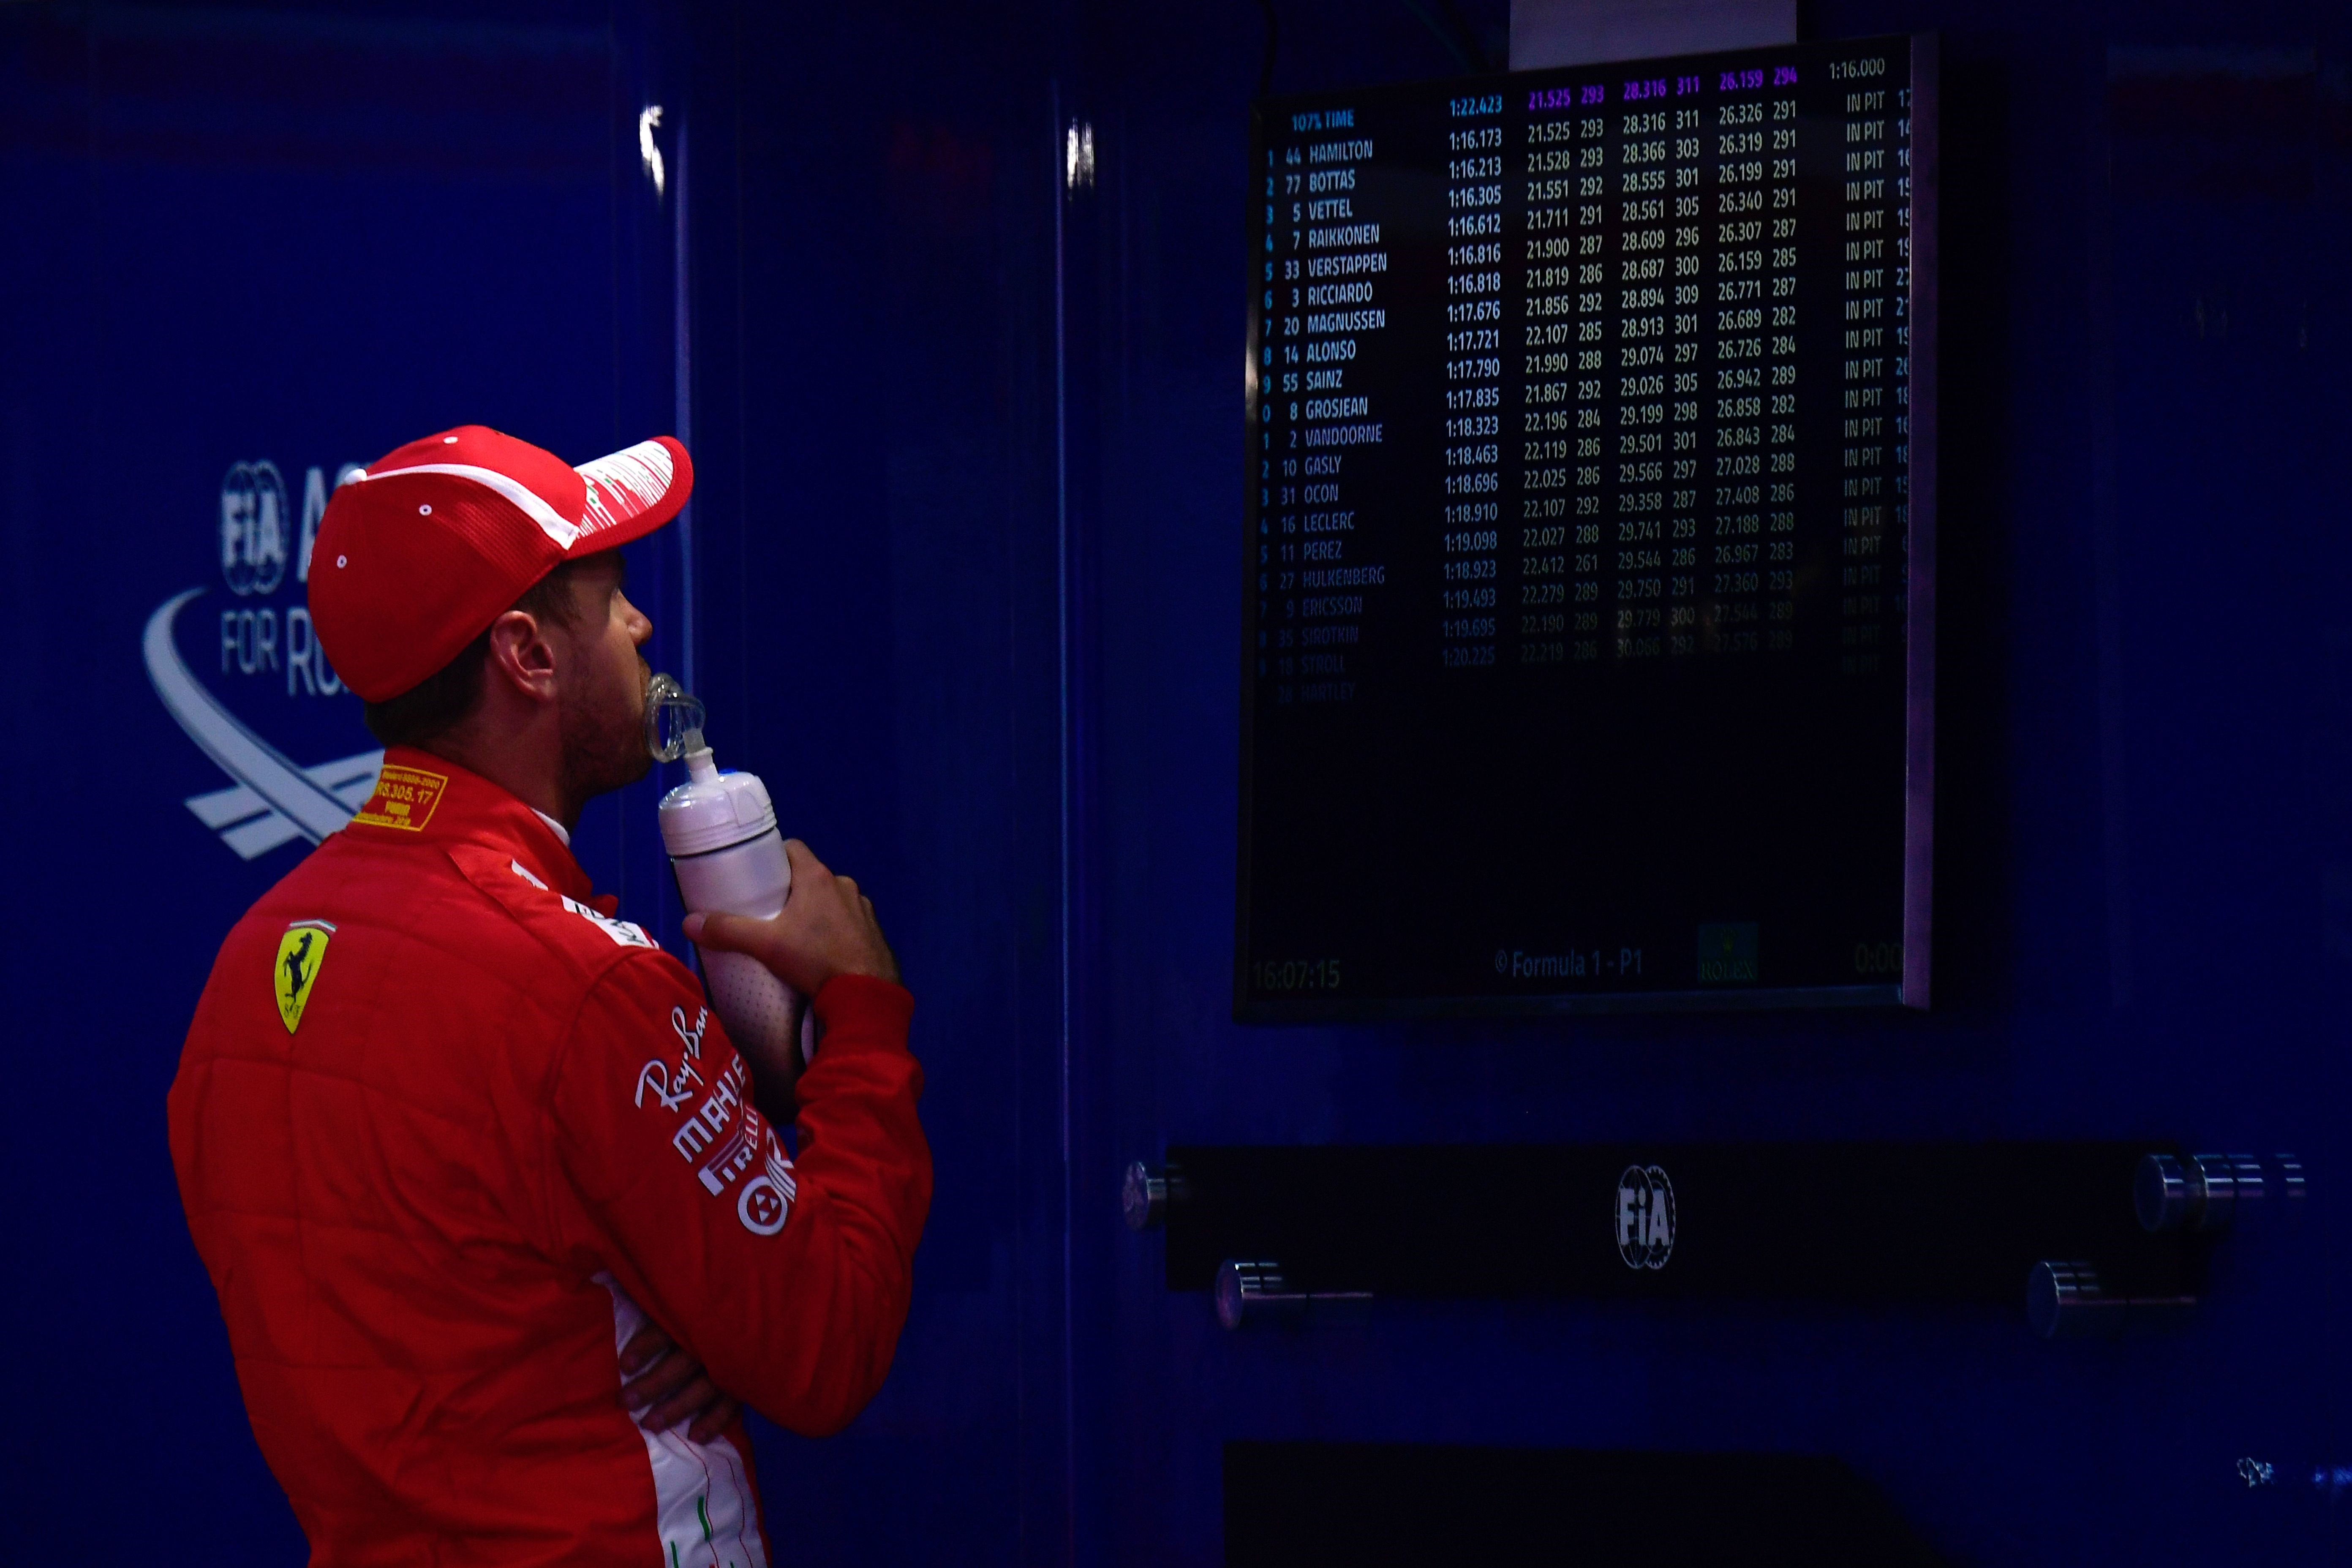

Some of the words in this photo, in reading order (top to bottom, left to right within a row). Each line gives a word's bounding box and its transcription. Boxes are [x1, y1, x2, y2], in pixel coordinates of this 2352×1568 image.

[1325, 109, 1354, 128] TIME
[1450, 95, 1502, 116] 1:22.423
[1529, 88, 1571, 110] 21.525
[1581, 84, 1604, 104] 293
[1624, 79, 1666, 101] 28.316
[1677, 76, 1699, 95] 311
[1720, 69, 1763, 90] 26.159
[1774, 67, 1797, 86] 294
[1829, 58, 1884, 79] 1:16.000
[1286, 147, 1301, 164] 44
[1310, 140, 1372, 163] HAMILTON
[1450, 128, 1501, 150] 1:16.173
[1528, 121, 1570, 143] 21.525
[1581, 118, 1603, 138] 293
[1623, 112, 1665, 134] 28.316
[1676, 109, 1698, 129] 311
[1719, 103, 1762, 125] 26.326
[1774, 100, 1795, 120] 291
[1847, 93, 1861, 112] IN
[1865, 90, 1885, 110] PIT
[1286, 174, 1301, 194] 77
[1309, 169, 1355, 192] BOTTAS
[1449, 156, 1501, 179] 1:16.213
[1528, 150, 1570, 172] 21.528
[1580, 147, 1603, 167] 293
[1623, 141, 1665, 163] 28.366
[1676, 138, 1699, 159] 303
[1719, 132, 1762, 154] 26.319
[1773, 129, 1795, 149] 291
[1847, 122, 1860, 142] IN
[1864, 120, 1884, 140] PIT
[1293, 203, 1301, 222] 5
[1309, 198, 1353, 220] VETTEL
[1449, 185, 1501, 207] 1:16.305
[1528, 180, 1568, 200] 21.551
[1580, 176, 1602, 196] 292
[1623, 170, 1665, 192] 28.555
[1676, 168, 1698, 188] 301
[1719, 161, 1762, 183] 26.199
[1773, 159, 1795, 178] 291
[1847, 152, 1860, 172] IN
[1864, 150, 1884, 169] PIT
[1293, 230, 1300, 249] 7
[1309, 224, 1379, 248] RAIKKONEN
[1448, 213, 1500, 236] 1:16.612
[1527, 208, 1568, 229] 21.711
[1580, 205, 1601, 225] 291
[1622, 199, 1663, 221] 28.561
[1676, 196, 1699, 217] 305
[1719, 190, 1762, 212] 26.340
[1773, 188, 1795, 208] 291
[1847, 182, 1860, 201] IN
[1864, 179, 1884, 199] PIT
[1285, 260, 1299, 279] 33
[1308, 253, 1386, 277] VERSTAPPEN
[1448, 243, 1500, 265] 1:16.816
[1527, 237, 1569, 259] 21.900
[1580, 235, 1602, 254] 287
[1622, 229, 1665, 250] 28.609
[1676, 226, 1699, 246] 296
[1719, 221, 1761, 242] 26.307
[1773, 218, 1796, 237] 287
[1847, 212, 1860, 231] IN
[1864, 210, 1884, 229] PIT
[1293, 288, 1299, 307] 3
[1308, 281, 1372, 305] RICCIARDO
[1448, 272, 1500, 294] 1:16.818
[1527, 266, 1568, 288] 21.819
[1580, 263, 1602, 283] 286
[1622, 259, 1664, 280] 28.687
[1676, 256, 1699, 276] 300
[1719, 250, 1762, 272] 26.159
[1773, 247, 1796, 267] 285
[1846, 242, 1860, 261] IN
[1864, 240, 1884, 259] PIT
[1284, 316, 1299, 335] 20
[1308, 309, 1385, 333] MAGNUSSEN
[1448, 300, 1500, 322] 1:17.676
[1527, 295, 1568, 316] 21.856
[1579, 293, 1601, 312] 292
[1622, 288, 1664, 308] 28.894
[1675, 285, 1699, 305] 309
[1718, 280, 1760, 300] 26.771
[1773, 277, 1796, 296] 287
[1846, 271, 1860, 290] IN
[1864, 269, 1883, 288] PIT
[1285, 345, 1298, 363] 14
[1307, 339, 1356, 362] ALONSO
[1448, 329, 1498, 351] 1:17.721
[1526, 324, 1568, 345] 22.107
[1579, 321, 1601, 341] 285
[1622, 316, 1663, 338] 28.913
[1675, 314, 1697, 334] 301
[1718, 308, 1761, 330] 26.689
[1772, 306, 1795, 326] 282
[1846, 301, 1859, 320] IN
[1863, 298, 1883, 318] PIT
[1283, 372, 1298, 392] 55
[1307, 369, 1342, 390] SAINZ
[1447, 357, 1500, 379] 1:17.790
[1846, 330, 1859, 348] IN
[1863, 328, 1883, 346] PIT
[1290, 402, 1298, 420] 8
[1306, 397, 1367, 419] GROSJEAN
[1447, 387, 1499, 408] 1:17.835
[1846, 360, 1859, 379] IN
[1863, 358, 1883, 377] PIT
[1290, 430, 1297, 448] 2
[1305, 423, 1382, 446] VANDOORNE
[1446, 415, 1498, 437] 1:18.323
[1845, 390, 1859, 408] IN
[1862, 388, 1883, 406] PIT
[1282, 458, 1297, 476] 10
[1305, 455, 1342, 475] GASLY
[1446, 444, 1498, 465] 1:18.463
[1282, 486, 1295, 505] 31
[1304, 483, 1338, 504] OCON
[1446, 472, 1498, 494] 1:18.696
[1281, 544, 1294, 561] 11
[1304, 540, 1342, 560] PEREZ
[1445, 530, 1497, 551] 1:19.098
[1282, 514, 1295, 533] 16
[1304, 511, 1354, 532] LECLERC
[1445, 502, 1497, 523] 1:18.910
[1280, 571, 1295, 590] 27
[1303, 565, 1385, 587] HULKENBERG
[1444, 559, 1496, 579] 1:18.923
[220, 609, 280, 675] FOR
[1253, 959, 1340, 990] 16:07:15
[1513, 948, 1585, 977] Formula
[1592, 950, 1600, 976] 1
[1621, 948, 1642, 975] P1
